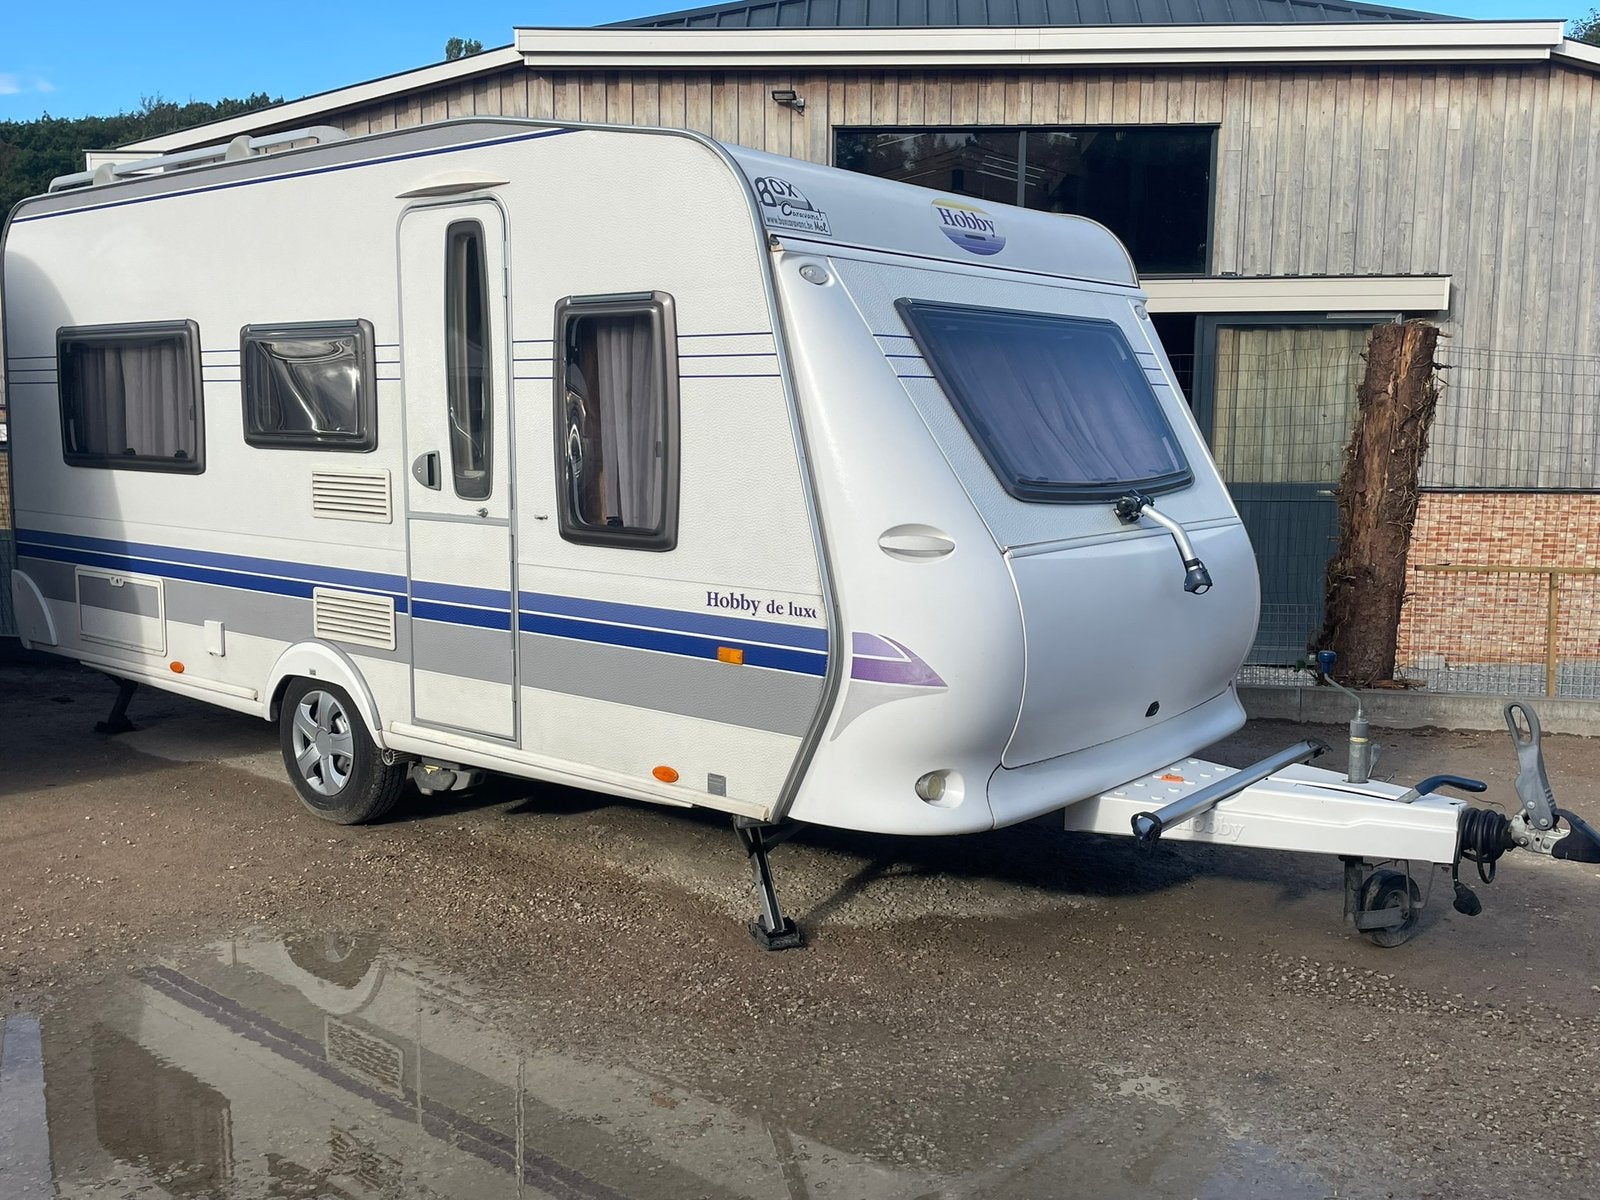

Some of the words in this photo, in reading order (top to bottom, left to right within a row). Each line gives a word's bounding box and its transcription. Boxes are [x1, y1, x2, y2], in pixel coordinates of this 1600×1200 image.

[936, 206, 996, 238] Hobby
[706, 591, 761, 616] Hobby
[766, 600, 784, 615] de
